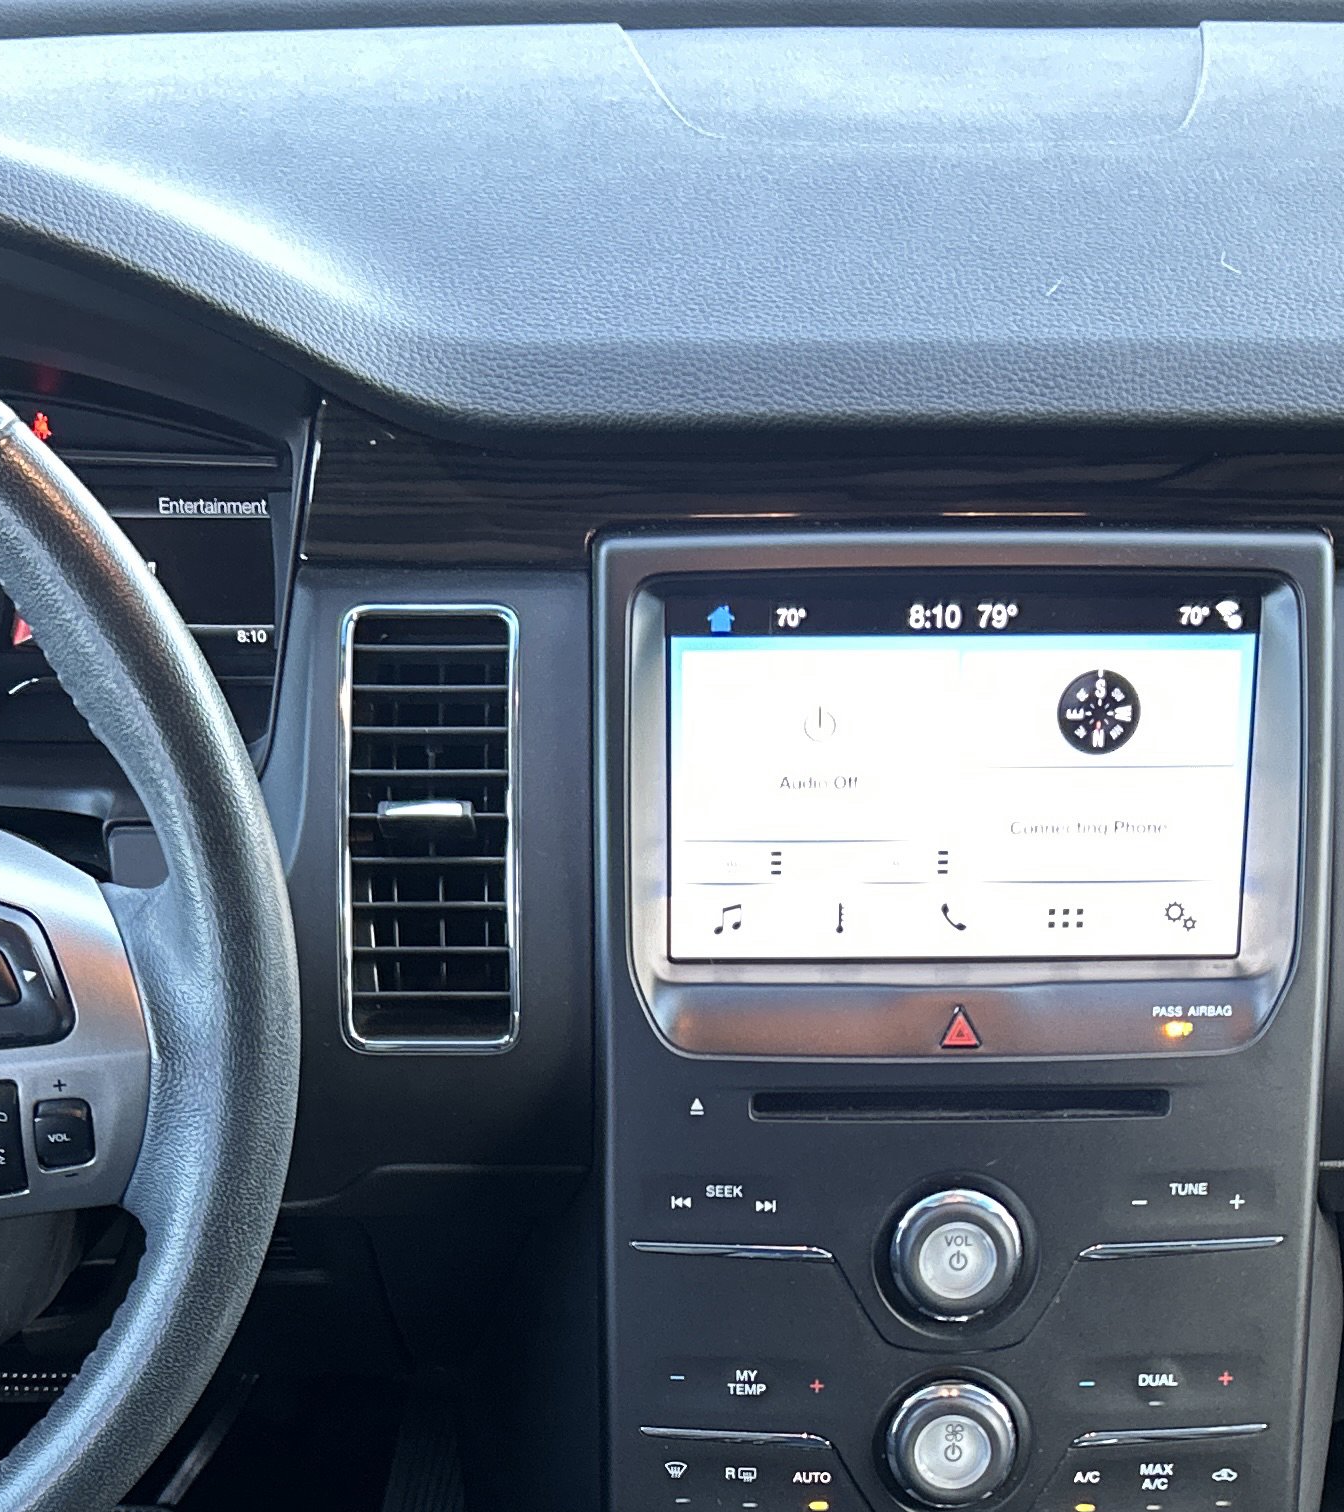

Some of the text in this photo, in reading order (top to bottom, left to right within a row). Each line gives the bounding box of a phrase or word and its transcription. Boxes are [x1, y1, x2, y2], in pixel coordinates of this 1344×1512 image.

[158, 497, 267, 515] Entertainment
[776, 607, 807, 627] 70°
[909, 603, 1018, 629] 8:10 79°
[1179, 605, 1210, 626] 70°
[237, 630, 266, 643] 8:10
[1095, 679, 1106, 699] S
[1152, 1006, 1233, 1017] PASS AIRBAG
[48, 1133, 72, 1143] VOL
[706, 1185, 743, 1198] SEEK
[1169, 1183, 1208, 1195] TUNE
[944, 1235, 972, 1247] VOL
[735, 1370, 758, 1382] MY
[1138, 1373, 1178, 1387] DUAL
[728, 1383, 766, 1396] TEMP
[725, 1467, 736, 1480] R
[1074, 1470, 1100, 1483] A/C
[1140, 1464, 1173, 1476] MAX
[793, 1472, 831, 1484] AUTO
[1142, 1477, 1168, 1490] A/C
